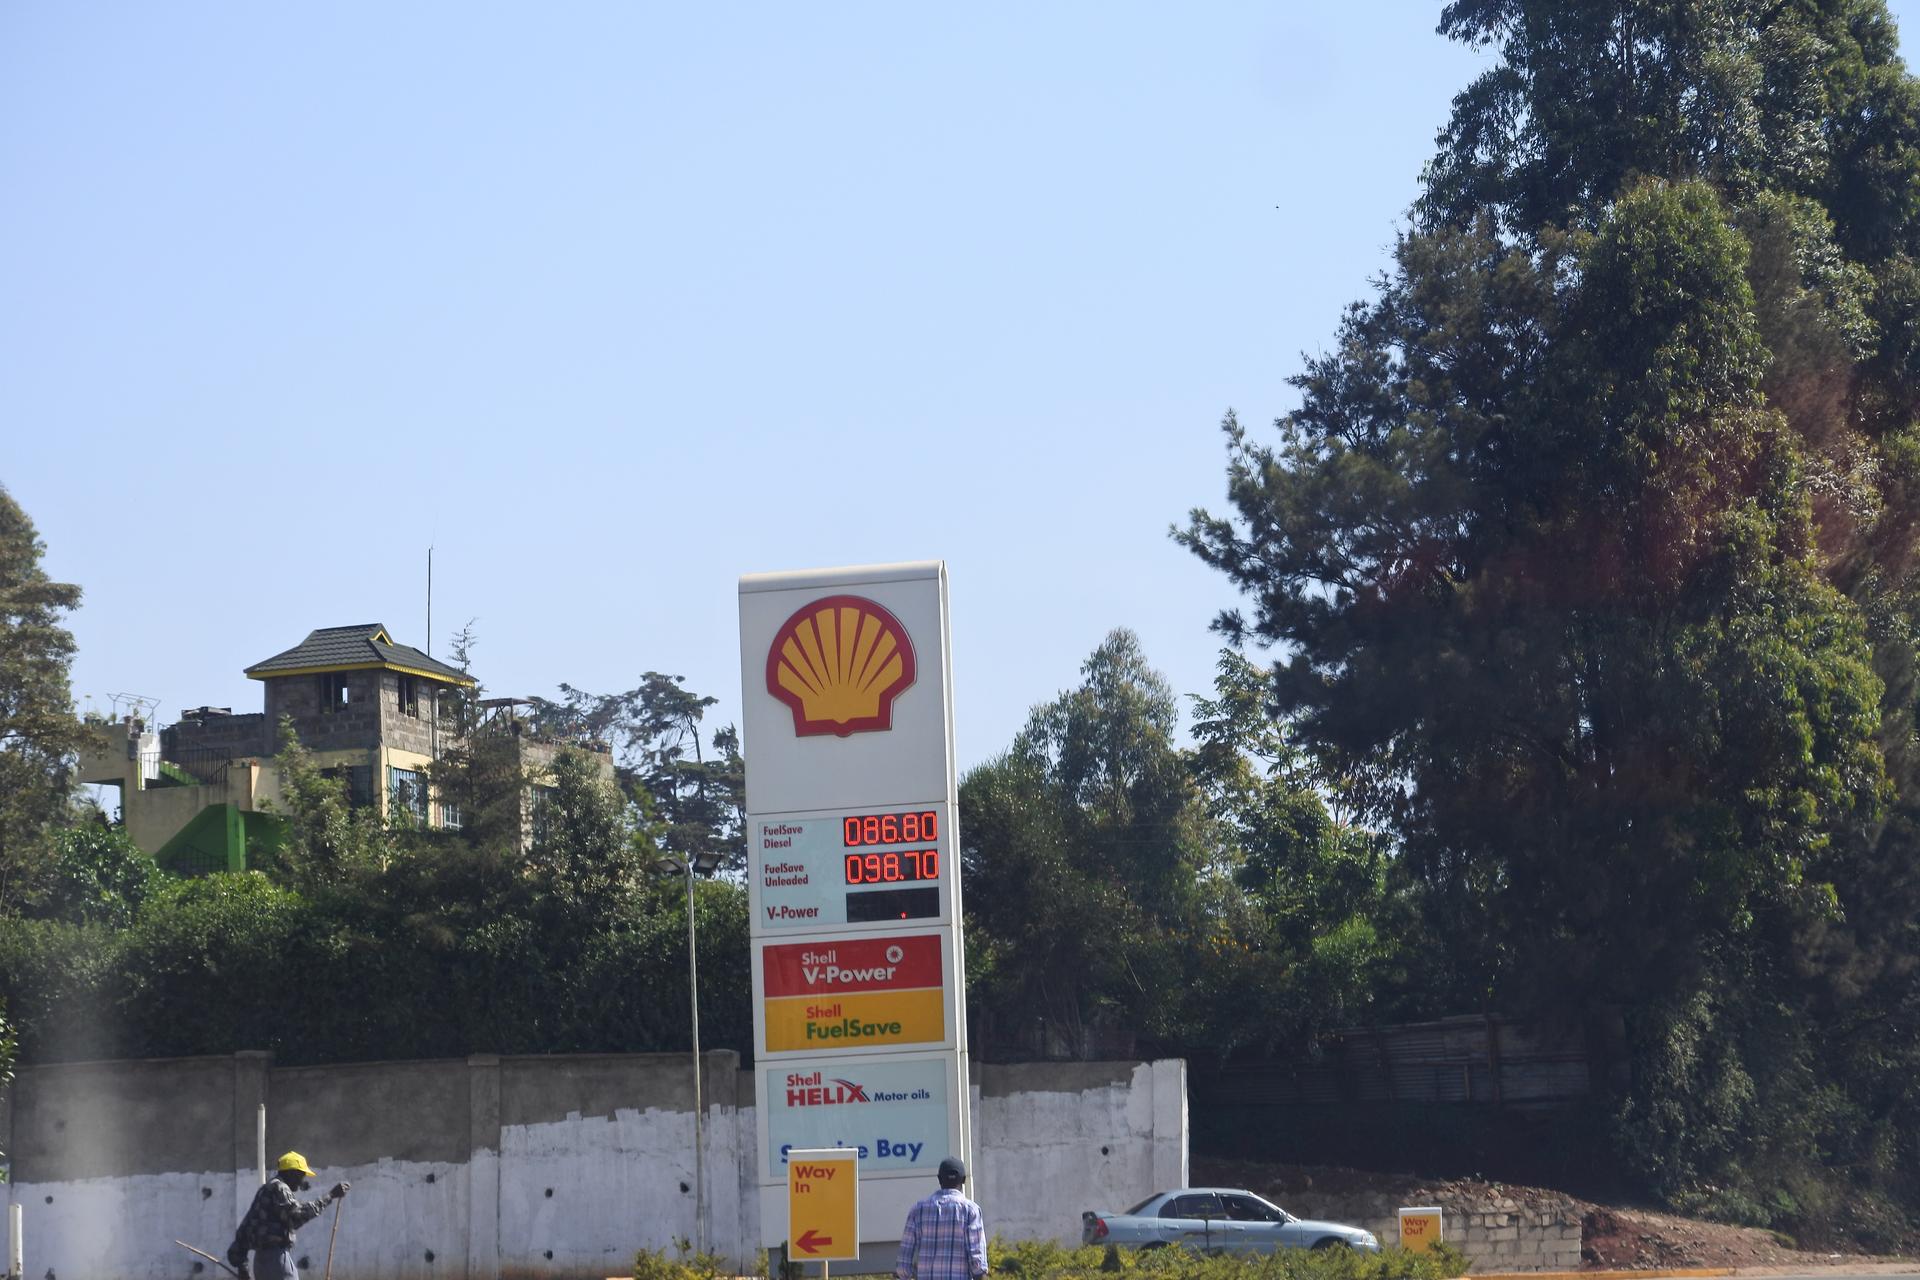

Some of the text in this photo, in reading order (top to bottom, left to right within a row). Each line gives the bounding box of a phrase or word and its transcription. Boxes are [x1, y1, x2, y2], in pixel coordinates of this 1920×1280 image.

[763, 825, 803, 835] FuelSave
[845, 812, 937, 846] 086.80
[764, 837, 791, 848] Diesel
[765, 863, 804, 874] FuelSave
[847, 851, 939, 883] 098.70
[765, 875, 808, 887] Unleaded
[767, 906, 819, 919] V-Power
[802, 951, 836, 965] Shell
[803, 966, 896, 985] V-Power
[806, 1004, 841, 1019] Shell
[806, 1019, 902, 1039] FuelSave
[787, 1072, 821, 1087] Shell
[787, 1083, 930, 1107] HELIX Motor oils
[877, 1139, 923, 1162] Bay
[795, 1165, 835, 1181] Way
[795, 1182, 810, 1193] In
[1403, 1217, 1429, 1227] Way
[1404, 1227, 1424, 1236] Out
